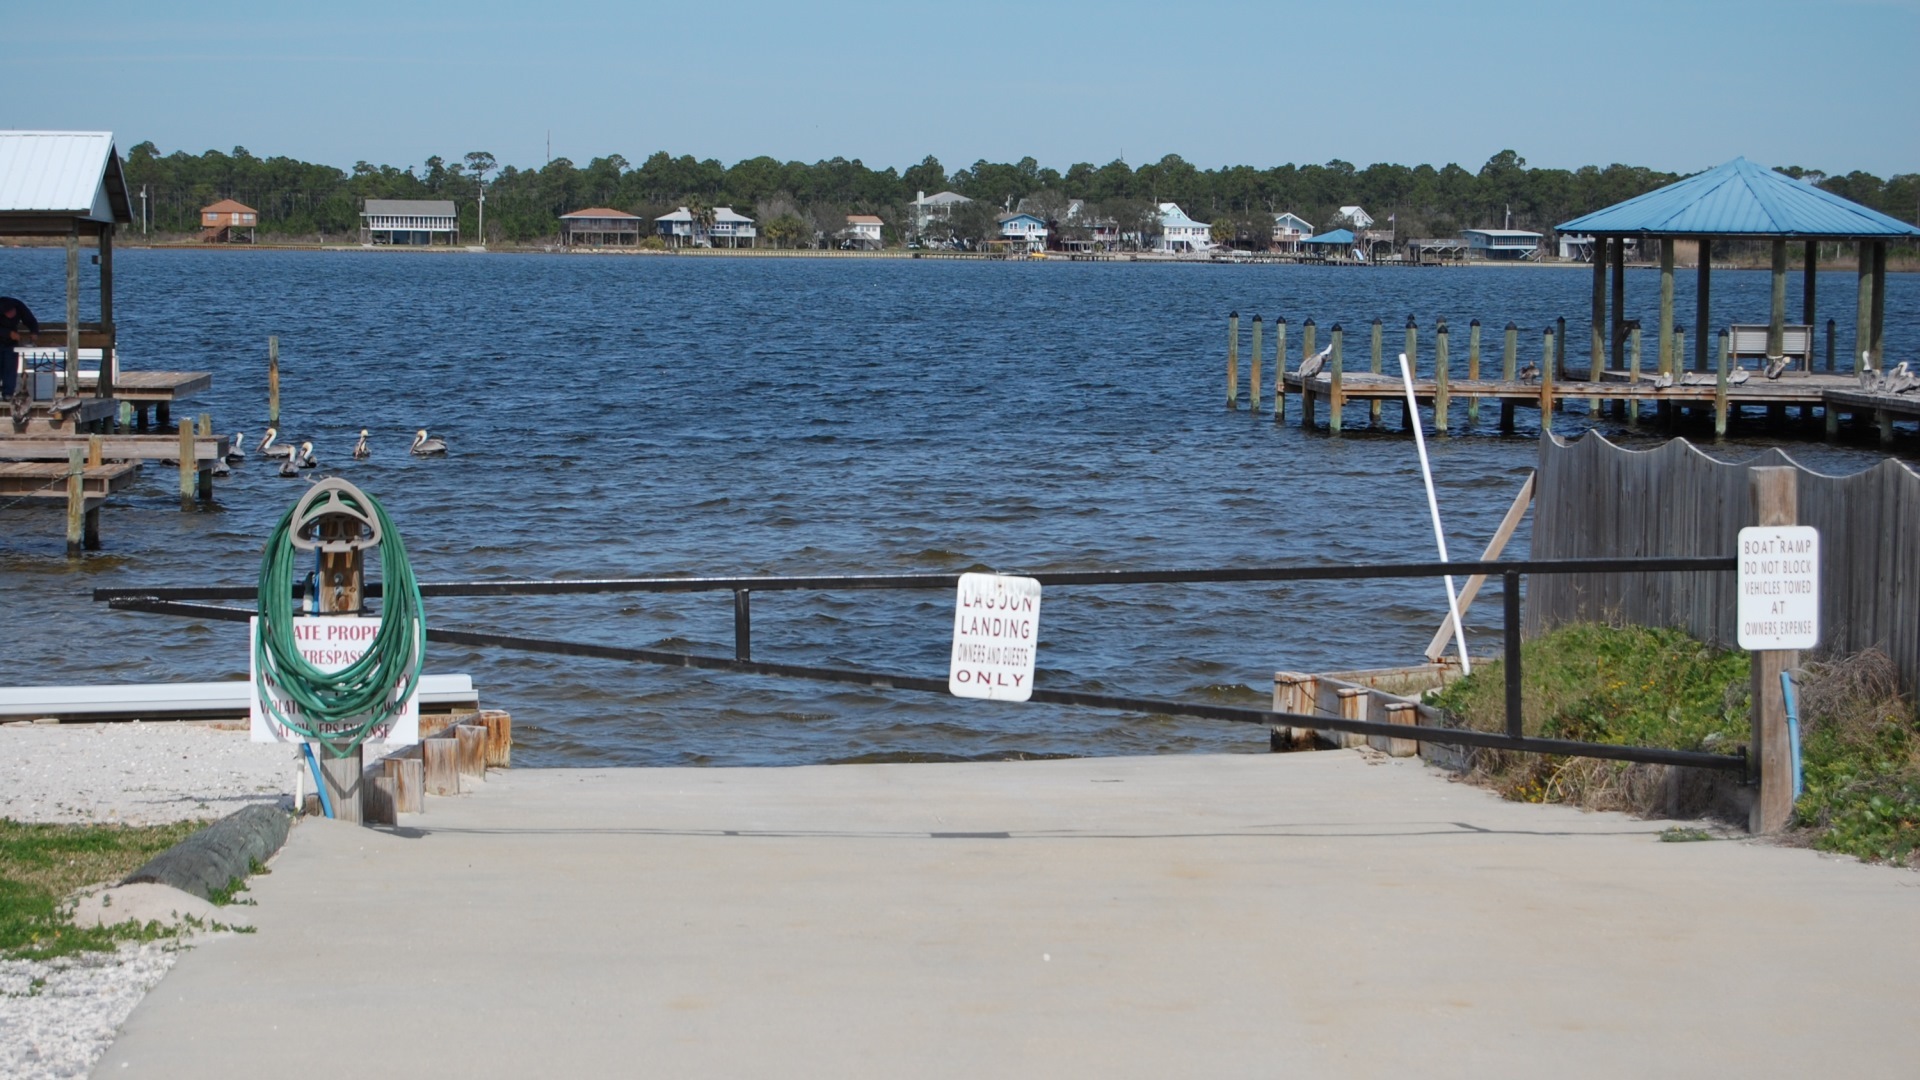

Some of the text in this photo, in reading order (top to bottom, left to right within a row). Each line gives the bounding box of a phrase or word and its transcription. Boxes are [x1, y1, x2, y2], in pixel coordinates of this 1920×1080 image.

[1744, 539, 1811, 555] BOAT RAMP
[1744, 559, 1811, 575] DO NOT BLOCK
[1744, 580, 1811, 595] VEHICLES TOWED
[963, 590, 1032, 612] LAGOON
[1771, 600, 1785, 614] AT
[961, 615, 1030, 639] LANDING
[1744, 620, 1812, 635] OWNERS EXPENSE
[958, 643, 1029, 667] OWNERS AND GUESTS
[956, 669, 1024, 687] ONLY
